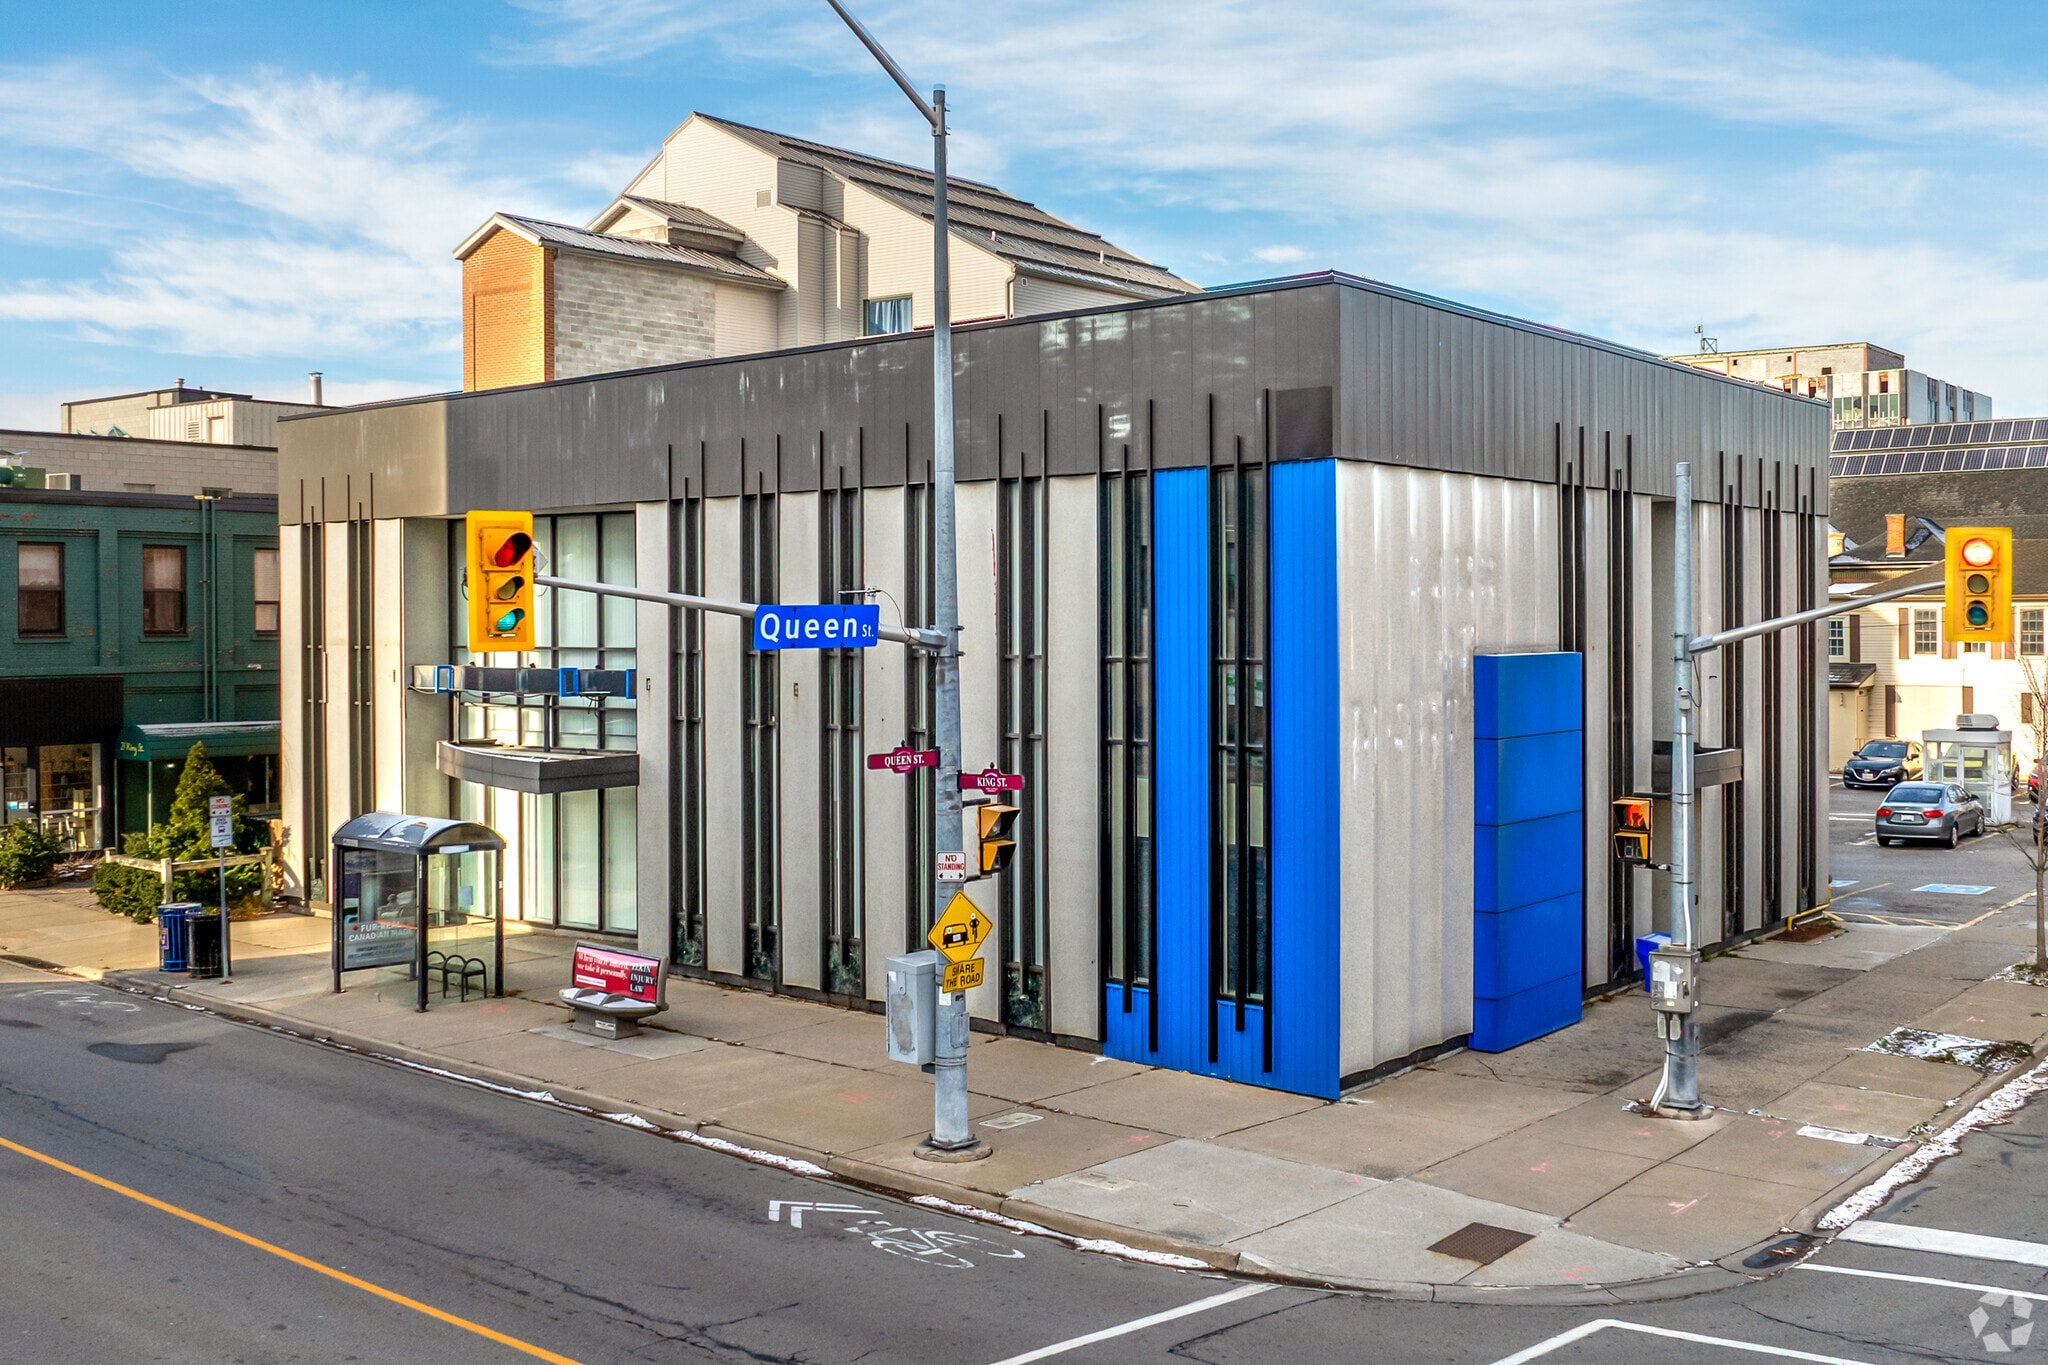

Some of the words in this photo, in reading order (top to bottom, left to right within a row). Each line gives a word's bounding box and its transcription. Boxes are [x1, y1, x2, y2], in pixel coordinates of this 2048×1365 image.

[760, 613, 857, 643] Queen
[862, 624, 874, 637] St.
[884, 755, 911, 767] QUEEN
[913, 754, 925, 764] ST.
[977, 777, 996, 787] KING
[997, 777, 1008, 787] ST.
[945, 854, 957, 862] NO
[938, 863, 965, 871] STANDING
[348, 929, 389, 942] CANADAN
[952, 962, 976, 977] SHARE
[630, 973, 655, 985] INJURY
[946, 976, 957, 988] THE
[960, 972, 981, 987] ROAD
[630, 984, 644, 992] LAW
